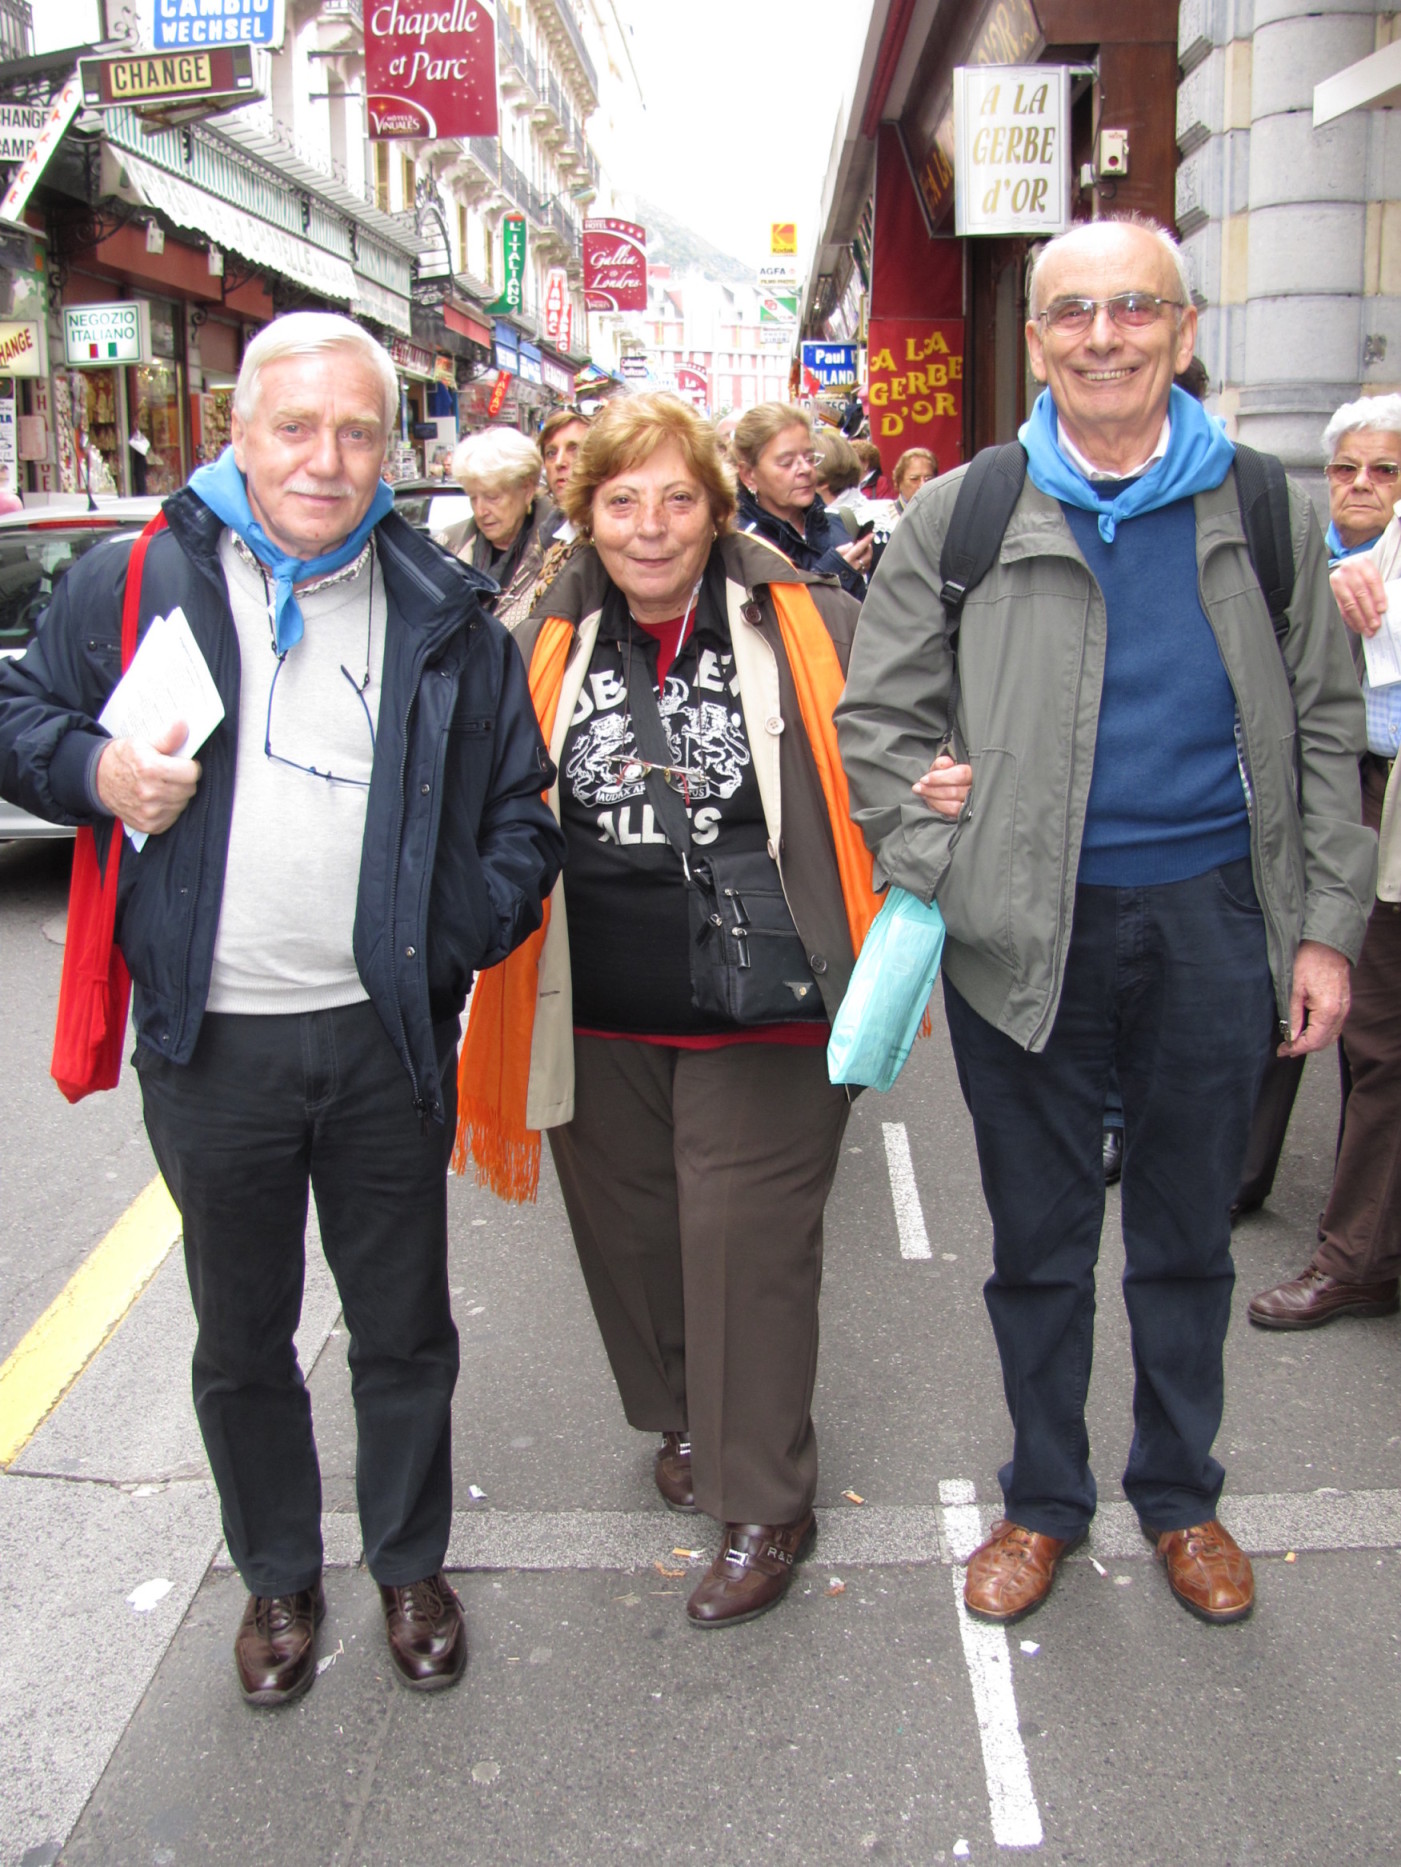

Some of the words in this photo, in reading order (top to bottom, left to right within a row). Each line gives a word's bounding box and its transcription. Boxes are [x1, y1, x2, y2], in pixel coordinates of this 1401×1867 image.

[162, 17, 265, 43] WECHSEL
[371, 0, 480, 44] Chapelle
[114, 56, 206, 91] CHANGE
[389, 55, 407, 75] et
[404, 52, 469, 88] Parc
[980, 84, 1001, 115] A
[1013, 84, 1048, 115] LA
[972, 126, 1056, 167] GERBE
[982, 178, 1048, 214] d'OR
[506, 221, 521, 306] L'ITALIANO
[590, 244, 639, 269] Gallia
[590, 270, 642, 289] Londres
[69, 312, 135, 327] NEGOZIO
[548, 276, 561, 333] TABAC
[71, 327, 135, 342] ITALIANO
[558, 304, 570, 351] TABAC
[816, 348, 845, 365] Paul
[870, 349, 897, 371] A
[906, 331, 949, 361] LA
[489, 371, 511, 413] TABAC
[808, 367, 854, 385] ULAND
[869, 356, 962, 406] GERBE
[881, 392, 957, 436] D'OR
[599, 788, 631, 802] AUDAX
